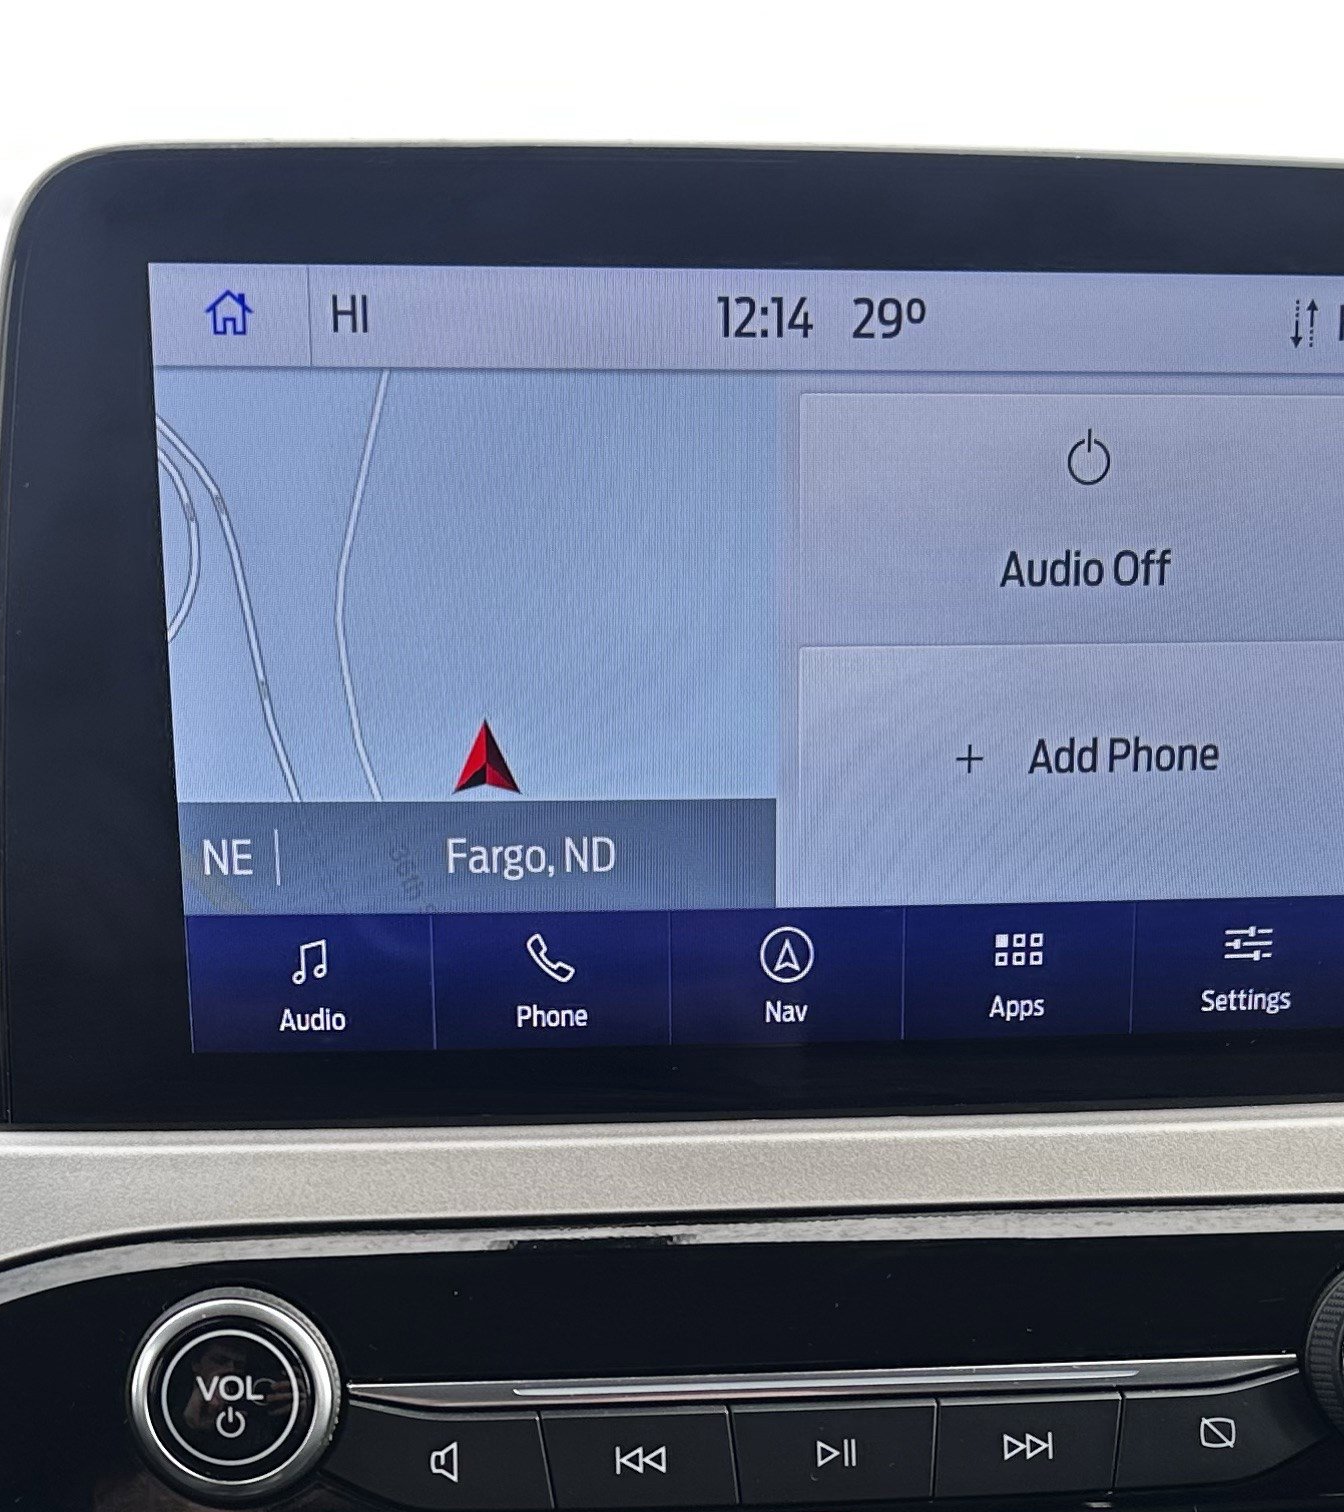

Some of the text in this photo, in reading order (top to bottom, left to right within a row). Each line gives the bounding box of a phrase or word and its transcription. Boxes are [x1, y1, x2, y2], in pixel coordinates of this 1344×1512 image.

[331, 294, 369, 334] HI
[717, 295, 814, 339] 12:14
[999, 547, 1173, 589] Audio Off
[1028, 734, 1220, 776] Add Phone
[202, 838, 254, 877] NE
[446, 835, 617, 884] Fargo, ND
[515, 1003, 589, 1029] Phone
[764, 999, 809, 1024] Nav
[988, 994, 1045, 1023] Apps
[1200, 987, 1292, 1016] Settings
[278, 1006, 347, 1033] Audio
[195, 1374, 265, 1403] VOL
